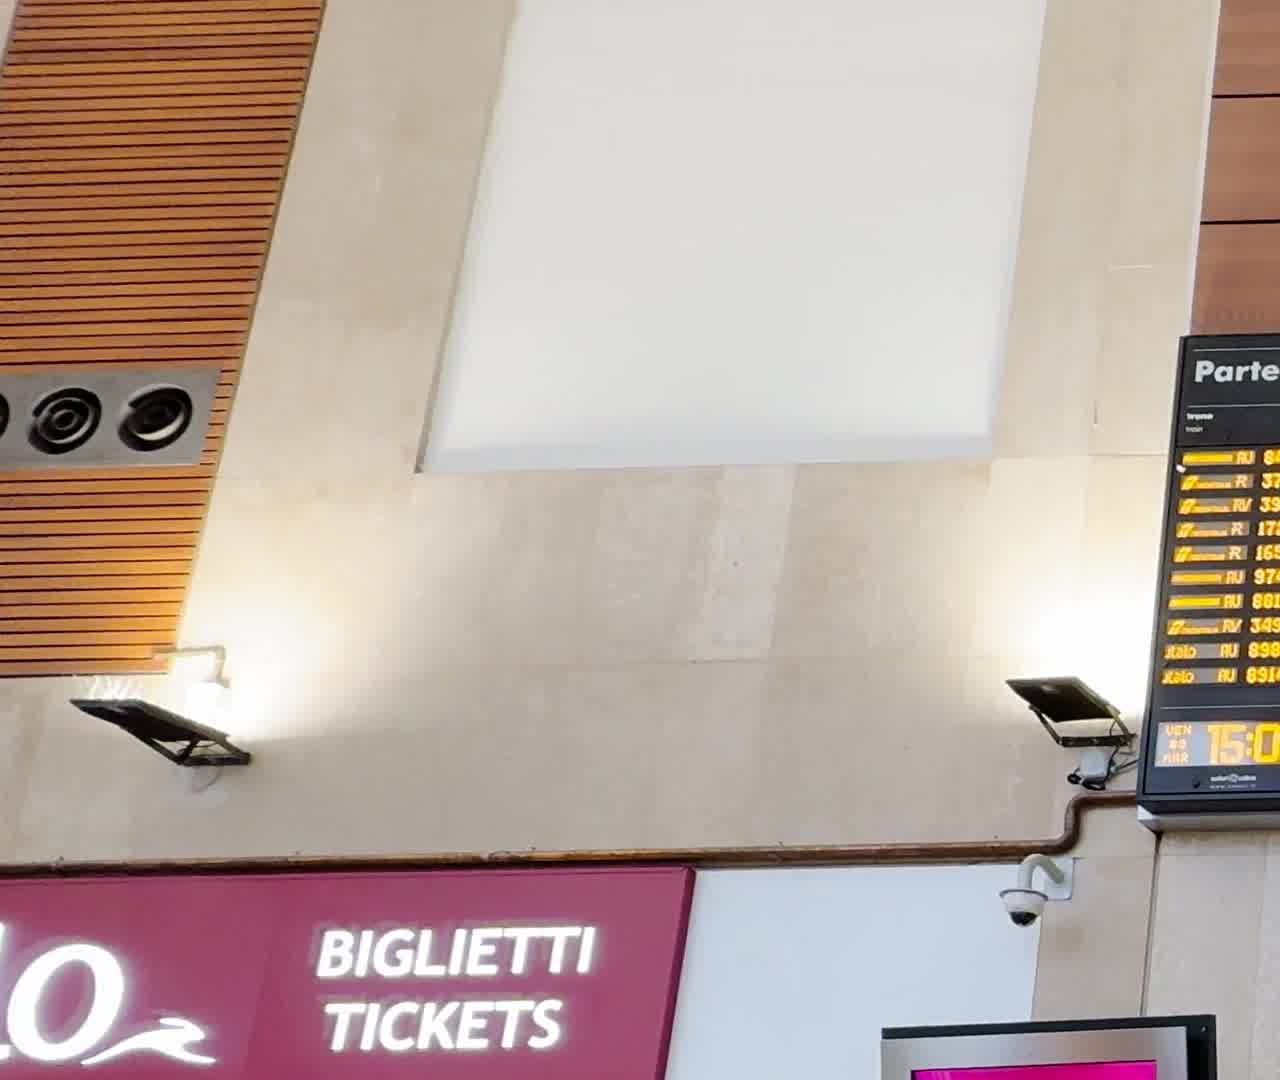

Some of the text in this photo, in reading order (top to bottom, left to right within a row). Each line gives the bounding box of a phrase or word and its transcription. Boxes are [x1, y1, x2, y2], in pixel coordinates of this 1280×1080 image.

[1234, 474, 1248, 489] R
[1231, 522, 1244, 537] R
[1229, 546, 1242, 561] R
[316, 926, 596, 978] BIGLIETTI
[324, 998, 563, 1052] TICKETS
